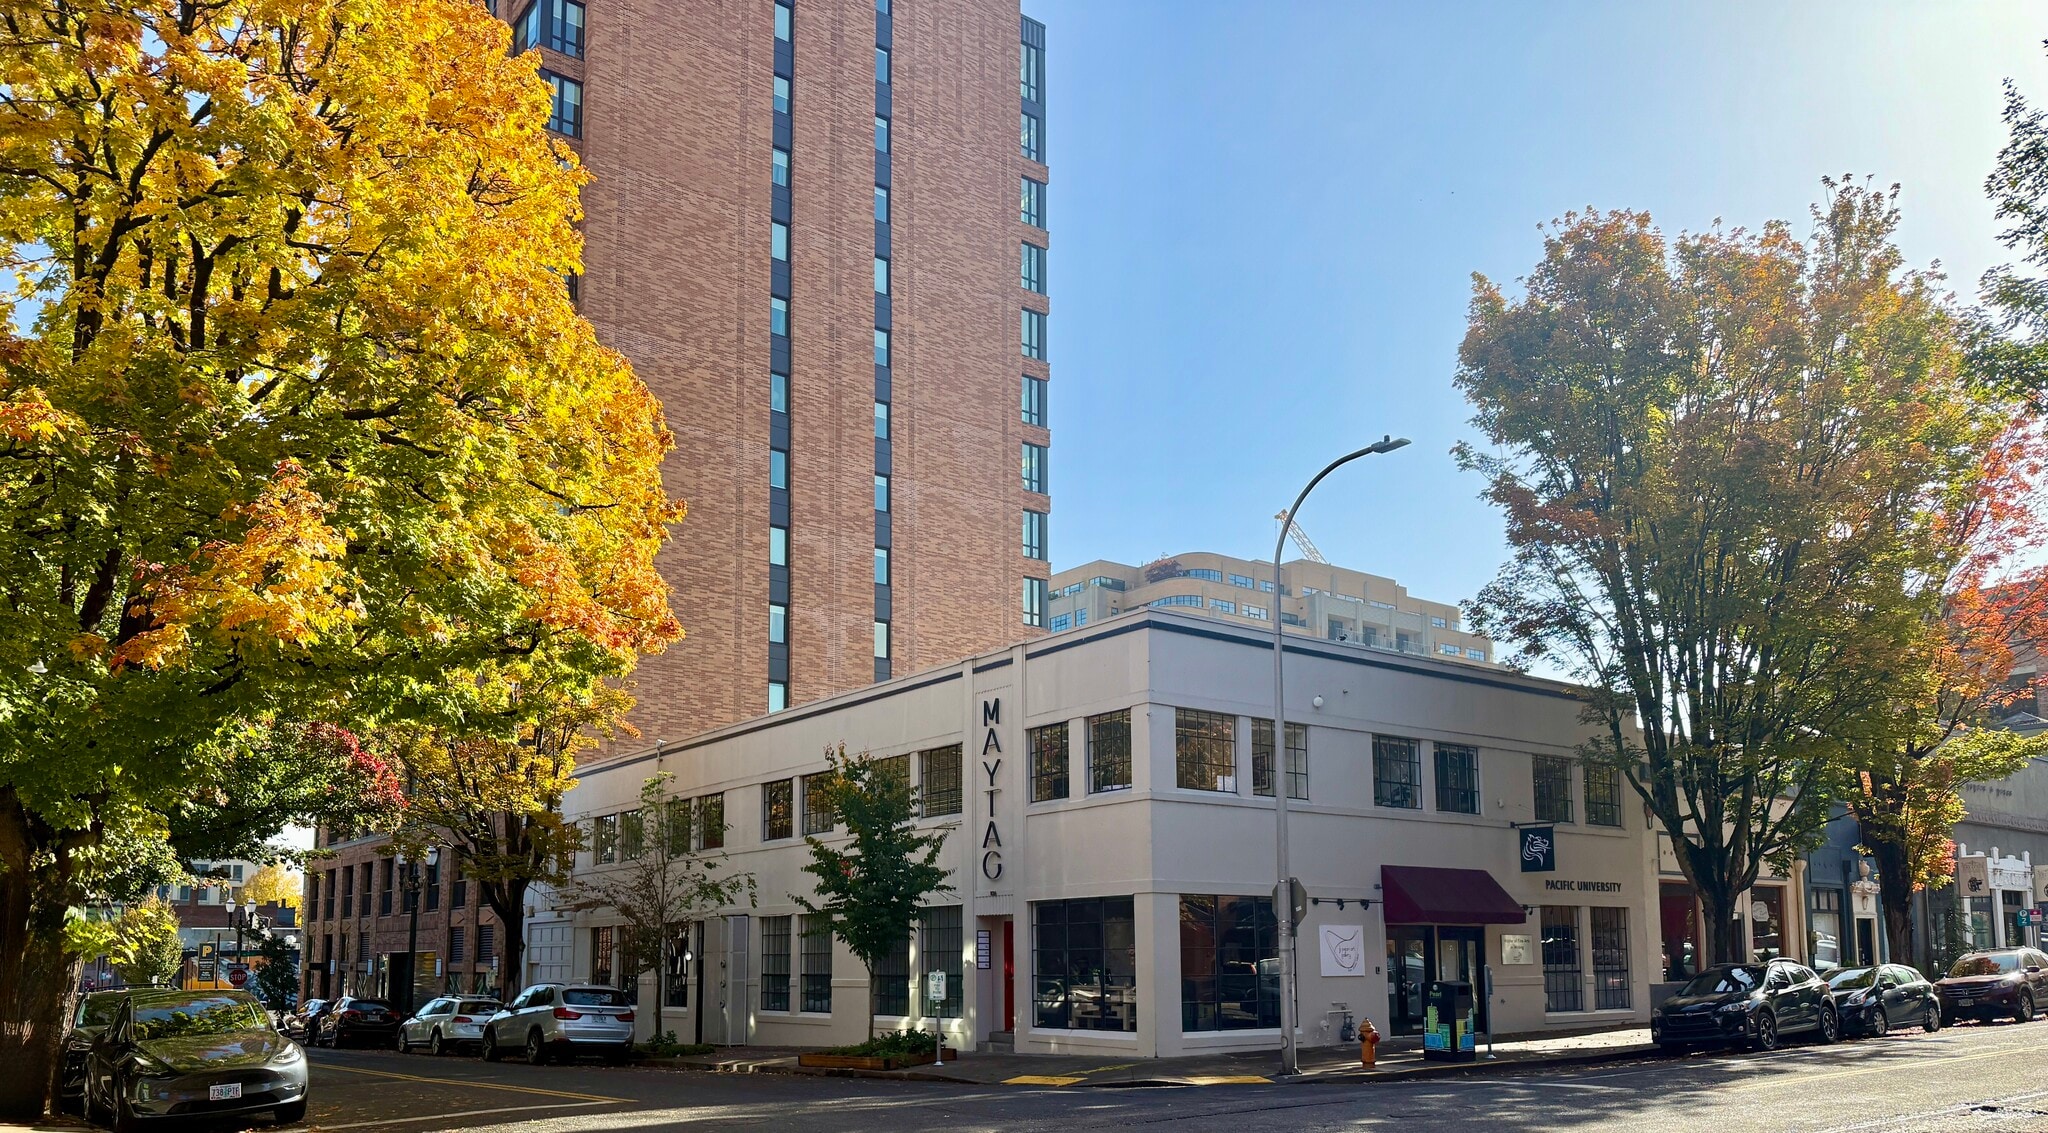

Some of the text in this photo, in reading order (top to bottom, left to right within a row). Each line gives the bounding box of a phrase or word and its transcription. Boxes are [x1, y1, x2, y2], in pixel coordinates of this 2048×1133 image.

[983, 697, 1002, 880] MAYTAG
[1545, 879, 1622, 892] PACIFIC UNIVERSITY
[202, 945, 213, 957] P
[230, 973, 247, 981] STOP
